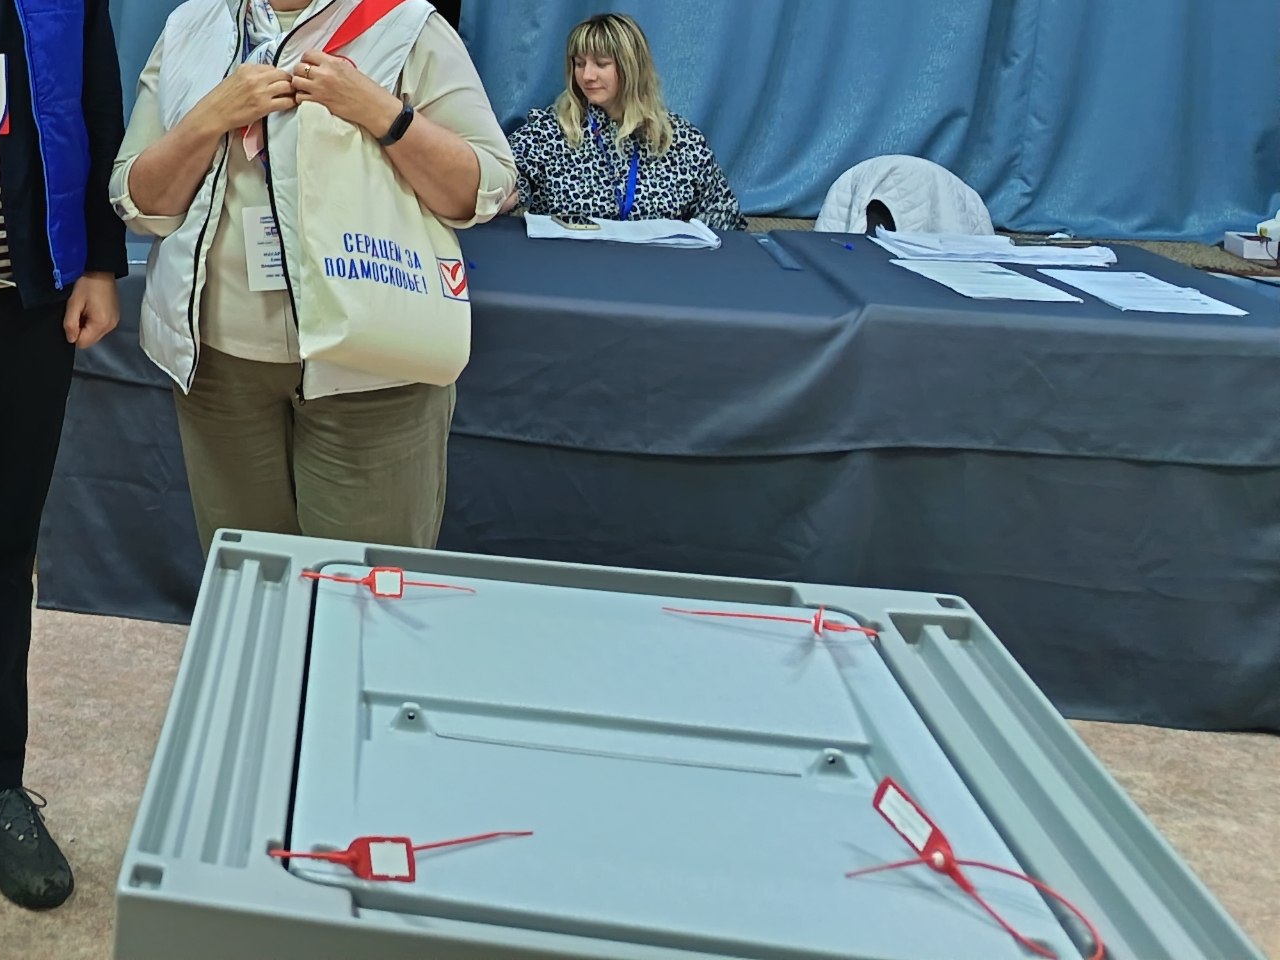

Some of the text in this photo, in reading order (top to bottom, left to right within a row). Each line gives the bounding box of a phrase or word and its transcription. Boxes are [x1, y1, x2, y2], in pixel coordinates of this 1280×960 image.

[343, 232, 423, 270] СЕРДЦЕМ ЗА
[324, 257, 429, 295] ПОДМОСКОВЬЕ!
